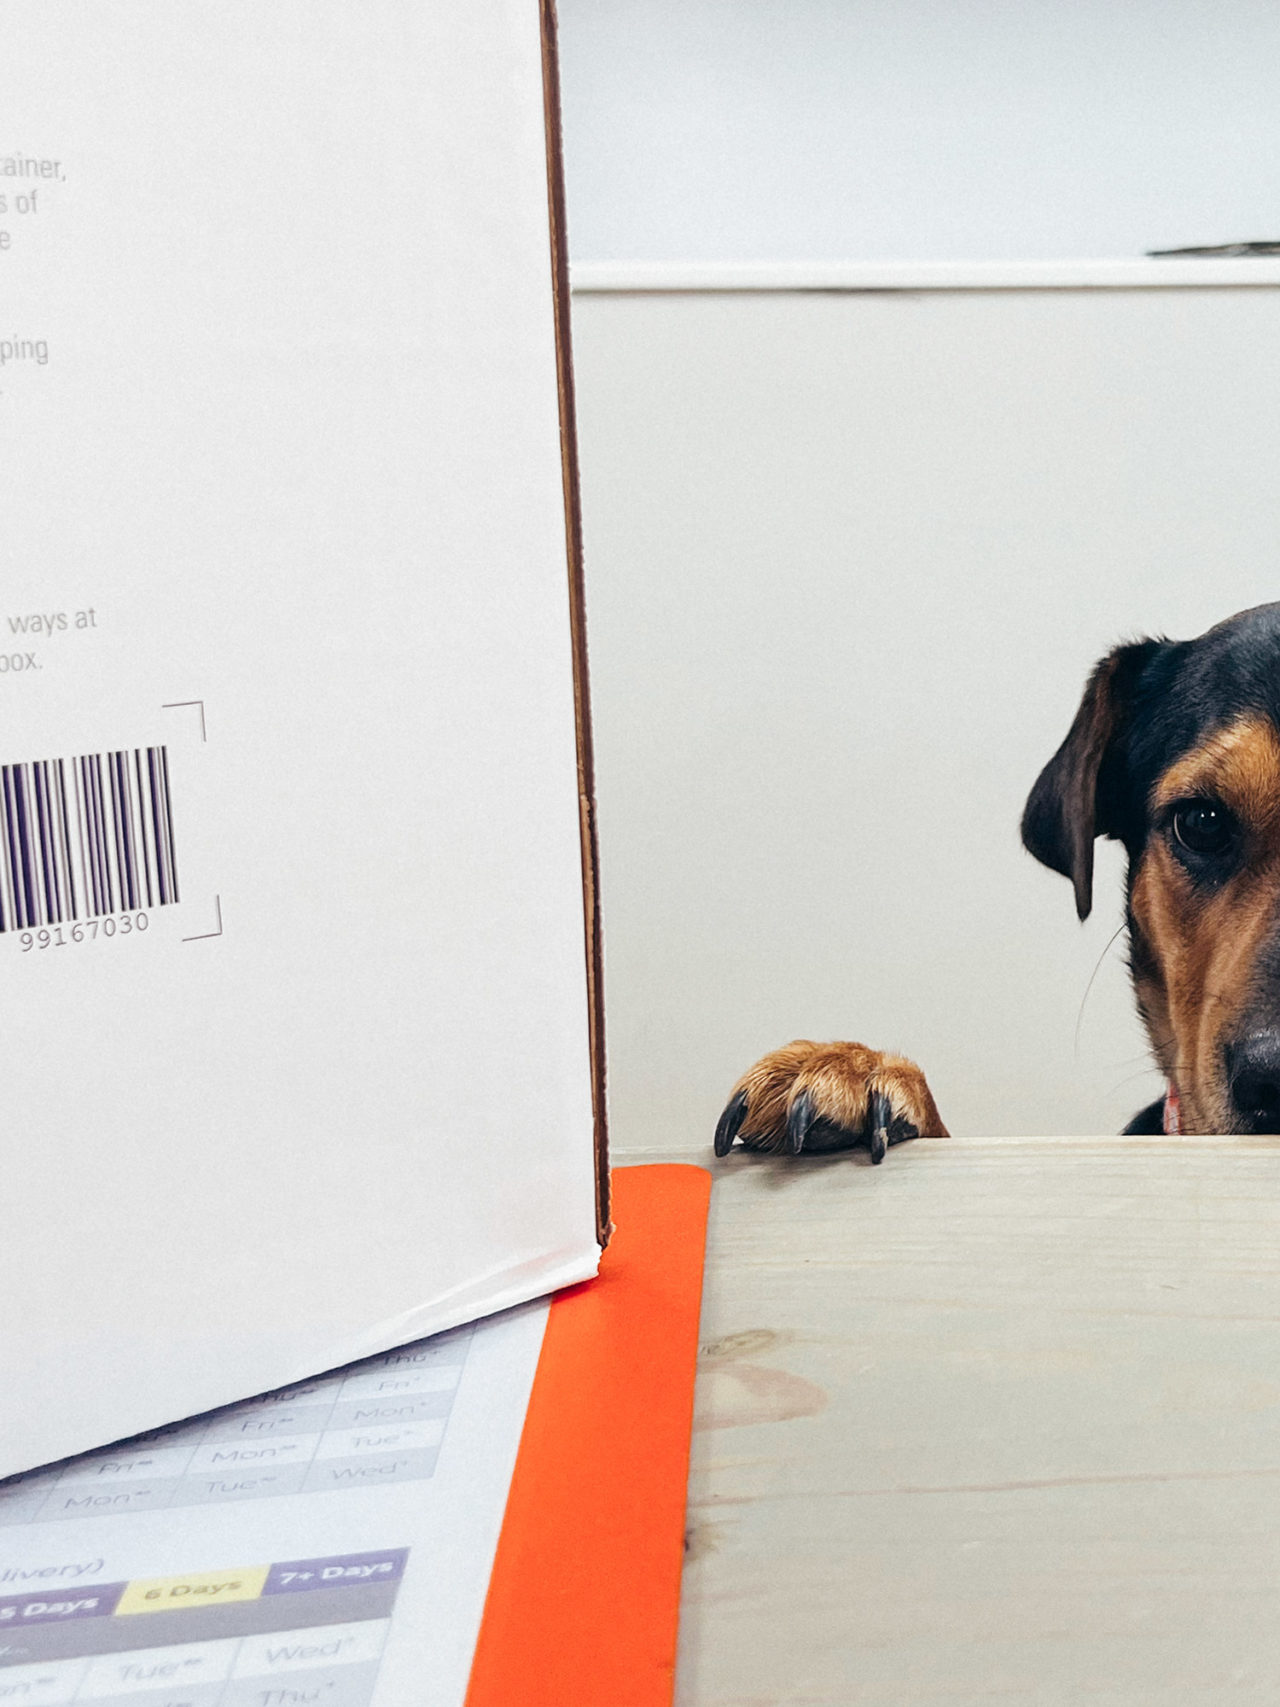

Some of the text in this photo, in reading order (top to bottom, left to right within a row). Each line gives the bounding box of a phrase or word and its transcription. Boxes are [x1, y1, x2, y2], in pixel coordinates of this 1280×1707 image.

[0, 151, 67, 182] ainer,
[15, 189, 38, 214] of
[0, 333, 48, 366] ping
[7, 607, 98, 638] ways at
[18, 912, 149, 952] 99167030
[279, 1561, 394, 1585] 7+ Days
[144, 1581, 242, 1601] 6 Days
[23, 1597, 100, 1617] Days
